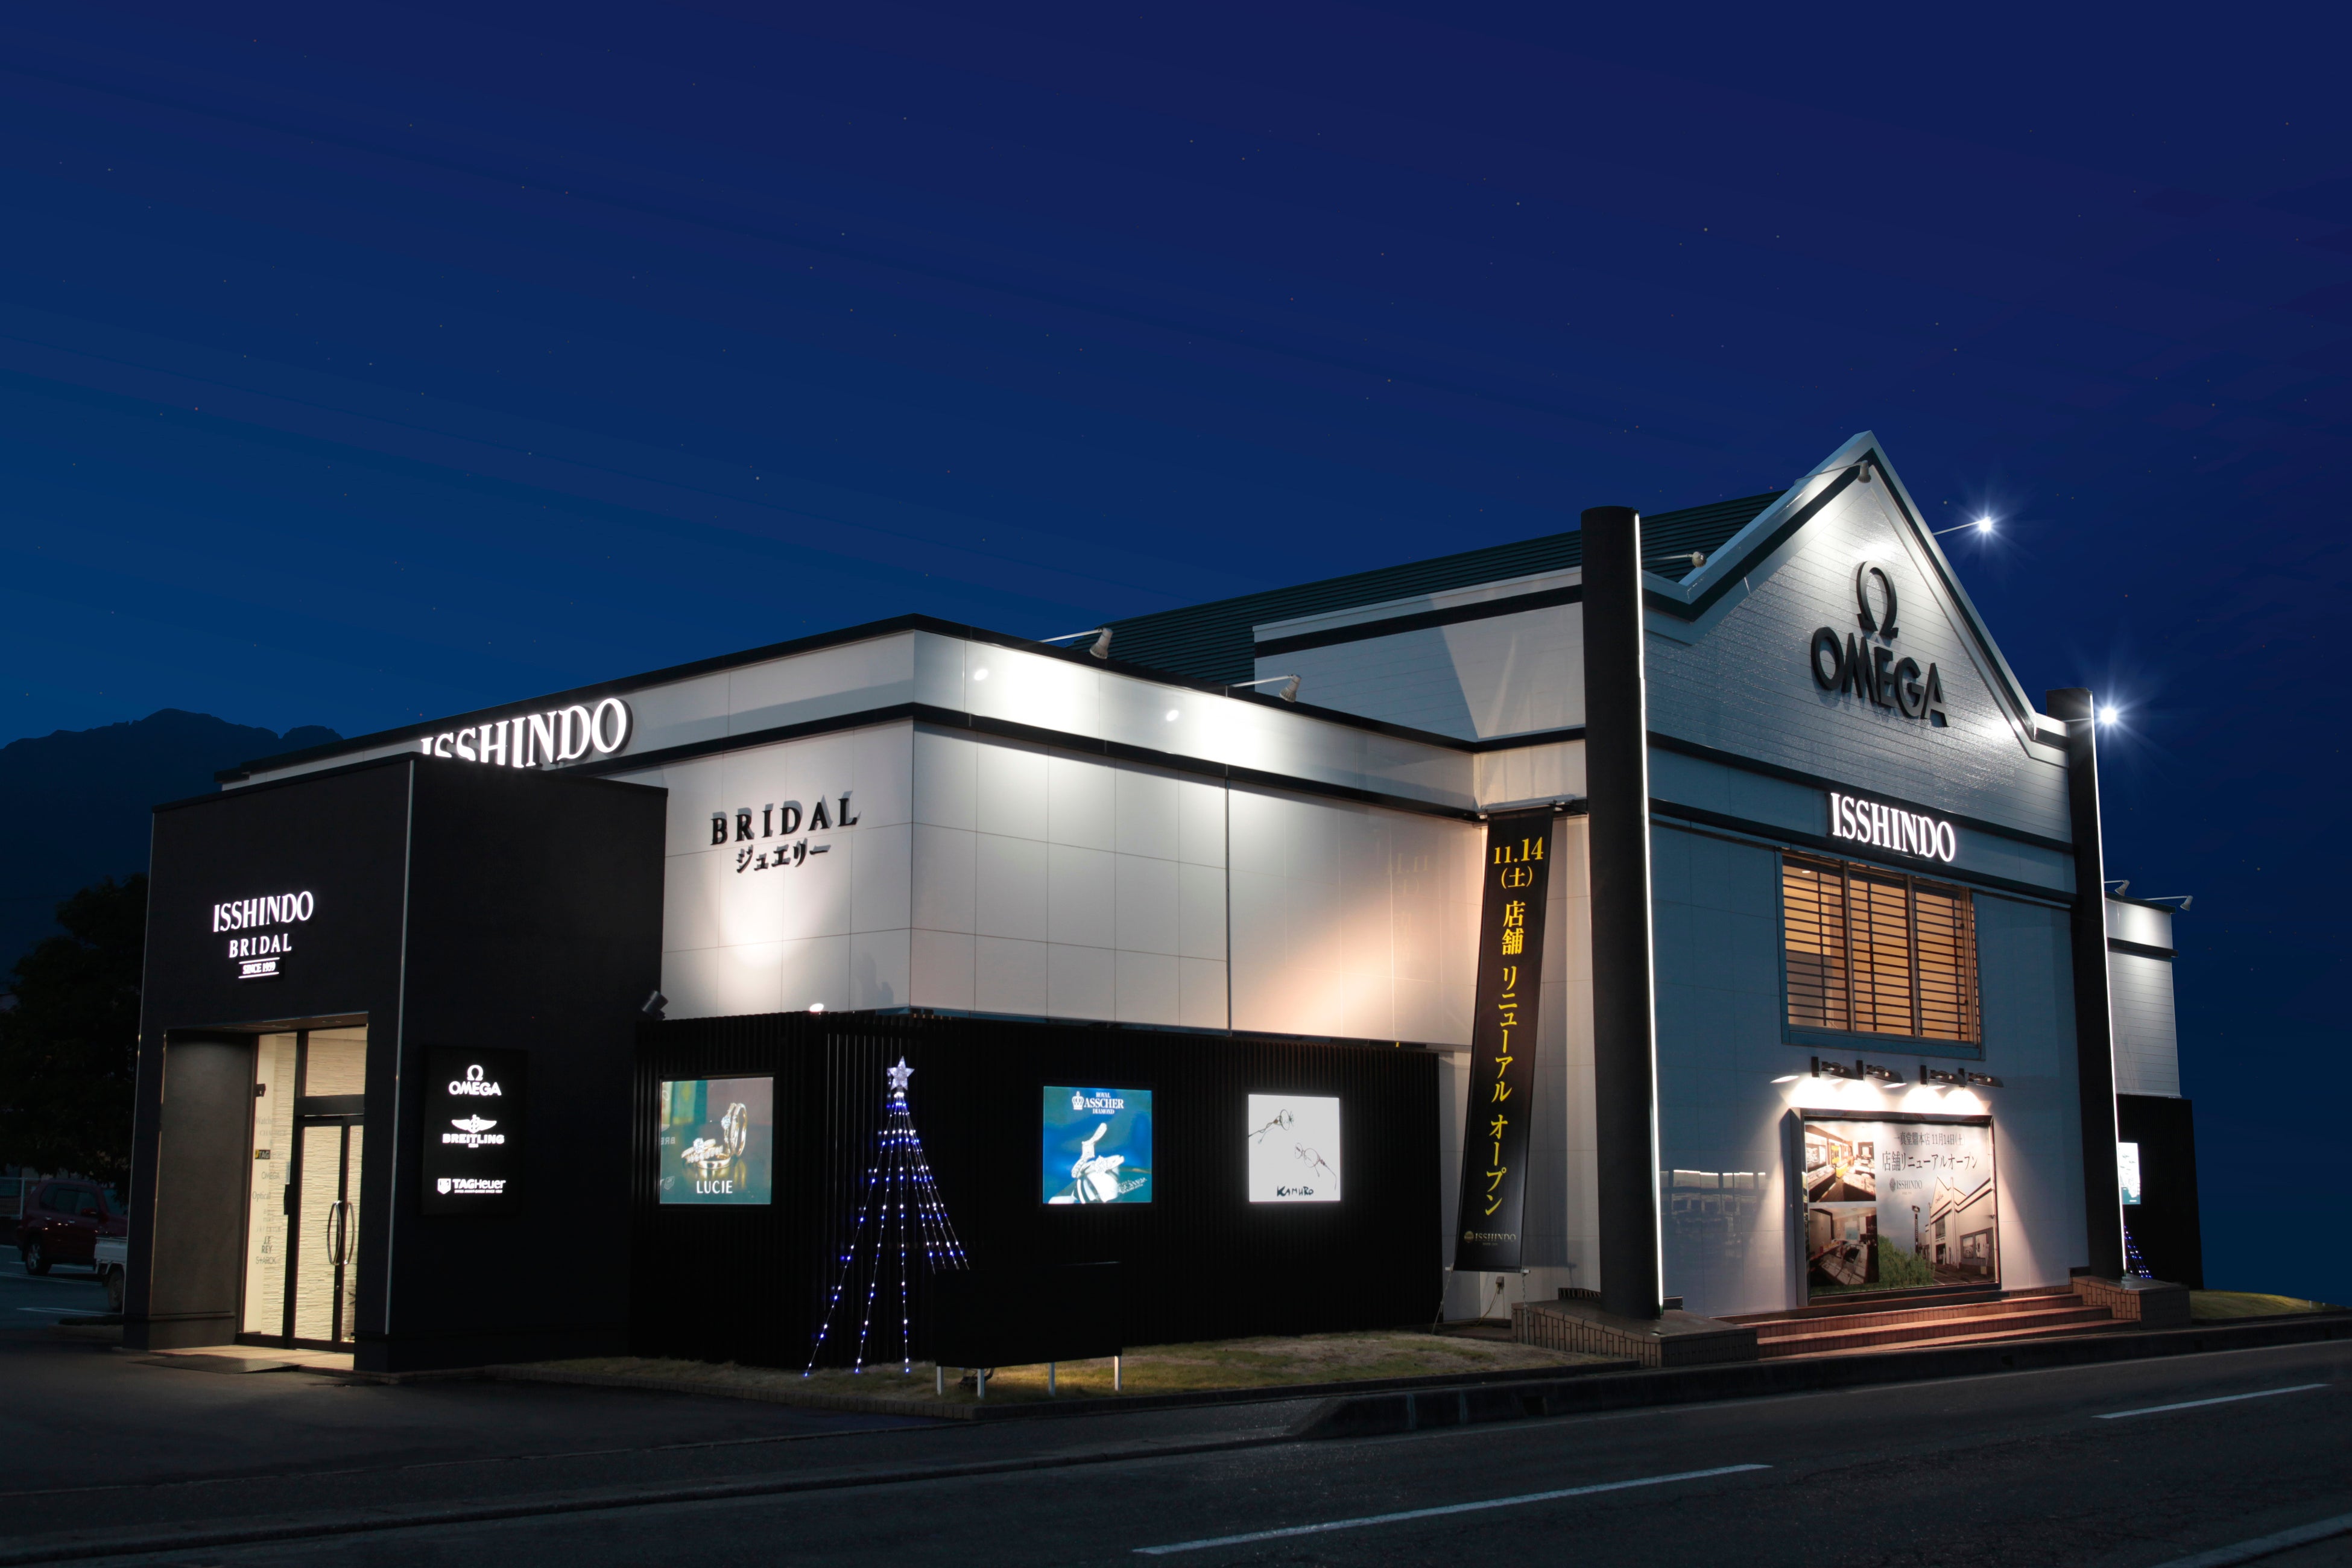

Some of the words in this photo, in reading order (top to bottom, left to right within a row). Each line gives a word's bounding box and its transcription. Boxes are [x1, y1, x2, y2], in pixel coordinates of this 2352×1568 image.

[1810, 627, 1948, 727] OMEGA
[710, 797, 858, 846] BRIDAL
[1830, 792, 1956, 863] ISSHINDO
[736, 842, 829, 874] ジュエリー
[1493, 836, 1544, 864] 11.14
[1501, 865, 1532, 889] (土)
[213, 890, 314, 933] ISSHINDO
[1502, 900, 1526, 955] 店舗
[229, 933, 292, 958] BRIDAL
[242, 963, 262, 975] SINCE
[1491, 966, 1519, 1104] リニューアル
[448, 1081, 502, 1096] OMEGA
[1083, 1098, 1124, 1109] ASSCHER
[442, 1133, 505, 1144] BREITLING
[1485, 1114, 1508, 1216] オープン
[1882, 1151, 1978, 1172] 店舗リニューアルオープン
[251, 1191, 271, 1202] Optical
[697, 1180, 733, 1194] LUCIE
[1896, 1180, 1923, 1190] ISSHINDO
[261, 1245, 273, 1254] REY
[1475, 1233, 1517, 1242] ISSHINDO
